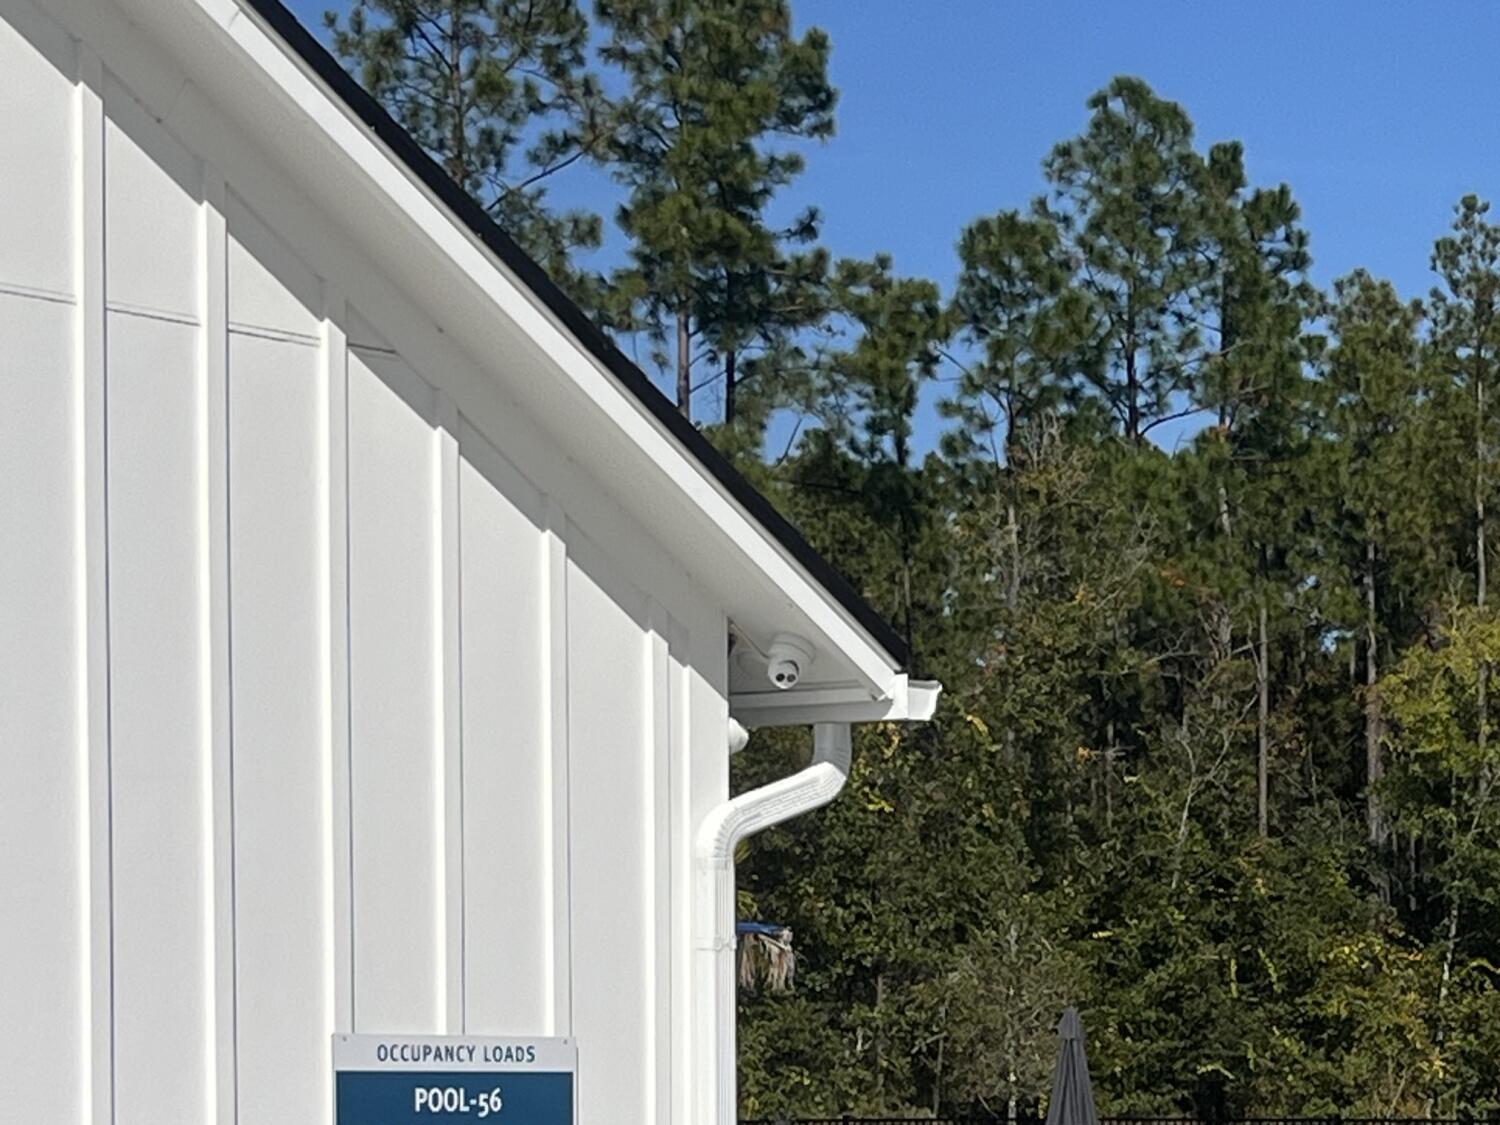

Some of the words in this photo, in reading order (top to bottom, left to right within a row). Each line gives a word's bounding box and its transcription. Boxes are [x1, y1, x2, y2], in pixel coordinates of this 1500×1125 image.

[377, 1043, 475, 1062] OCCUPANCY
[483, 1045, 536, 1063] LOADS
[414, 1087, 503, 1117] POOL-56
